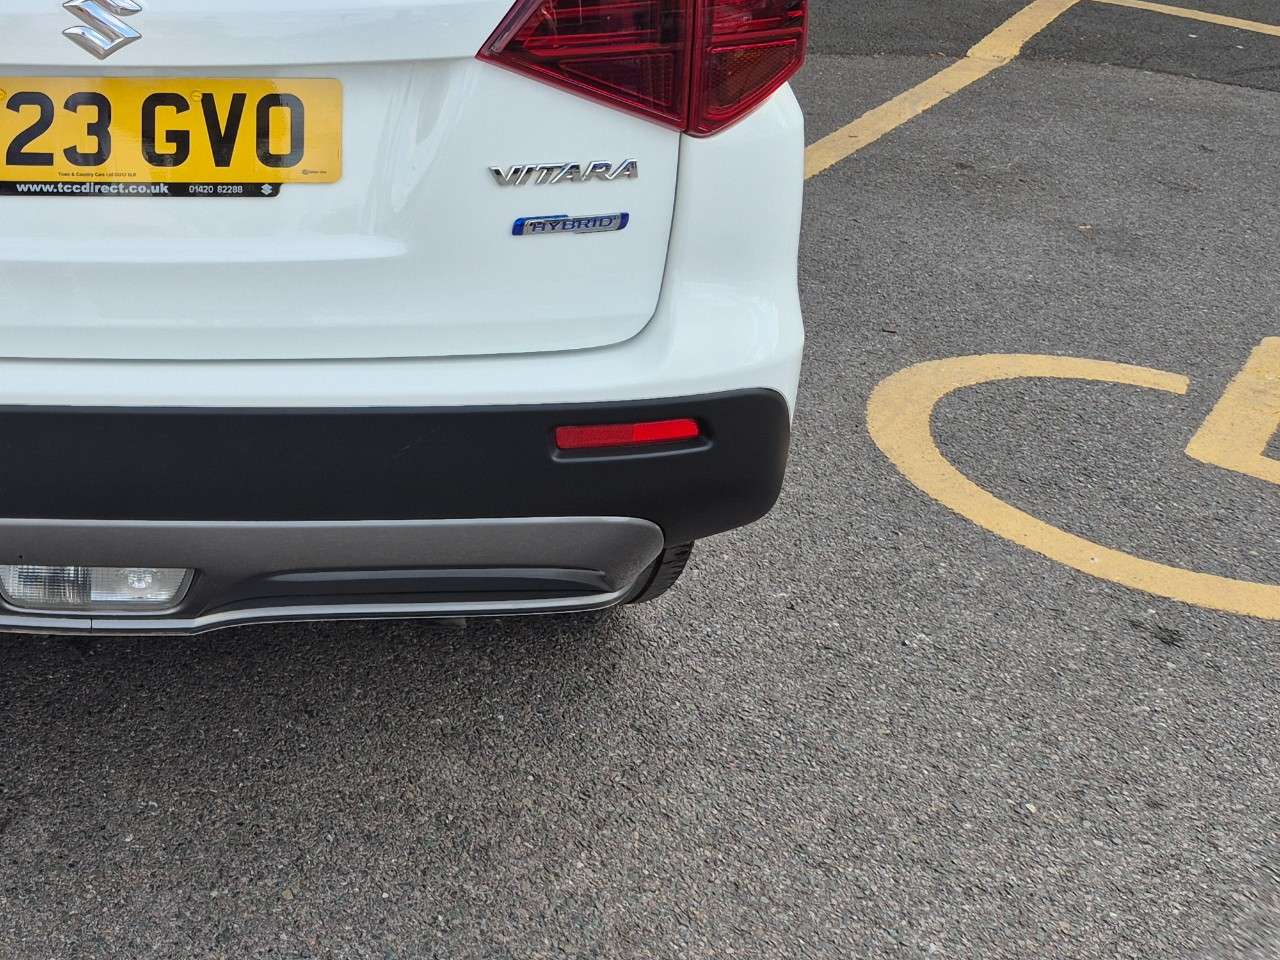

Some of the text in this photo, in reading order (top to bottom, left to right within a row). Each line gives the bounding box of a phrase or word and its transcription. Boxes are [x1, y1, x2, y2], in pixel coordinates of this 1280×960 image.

[141, 92, 305, 169] GVO
[488, 158, 639, 186] VITARA
[16, 182, 169, 194] www.tccdirect.co.uk
[188, 185, 243, 194] 01420 82288
[528, 215, 617, 232] HYBRID
